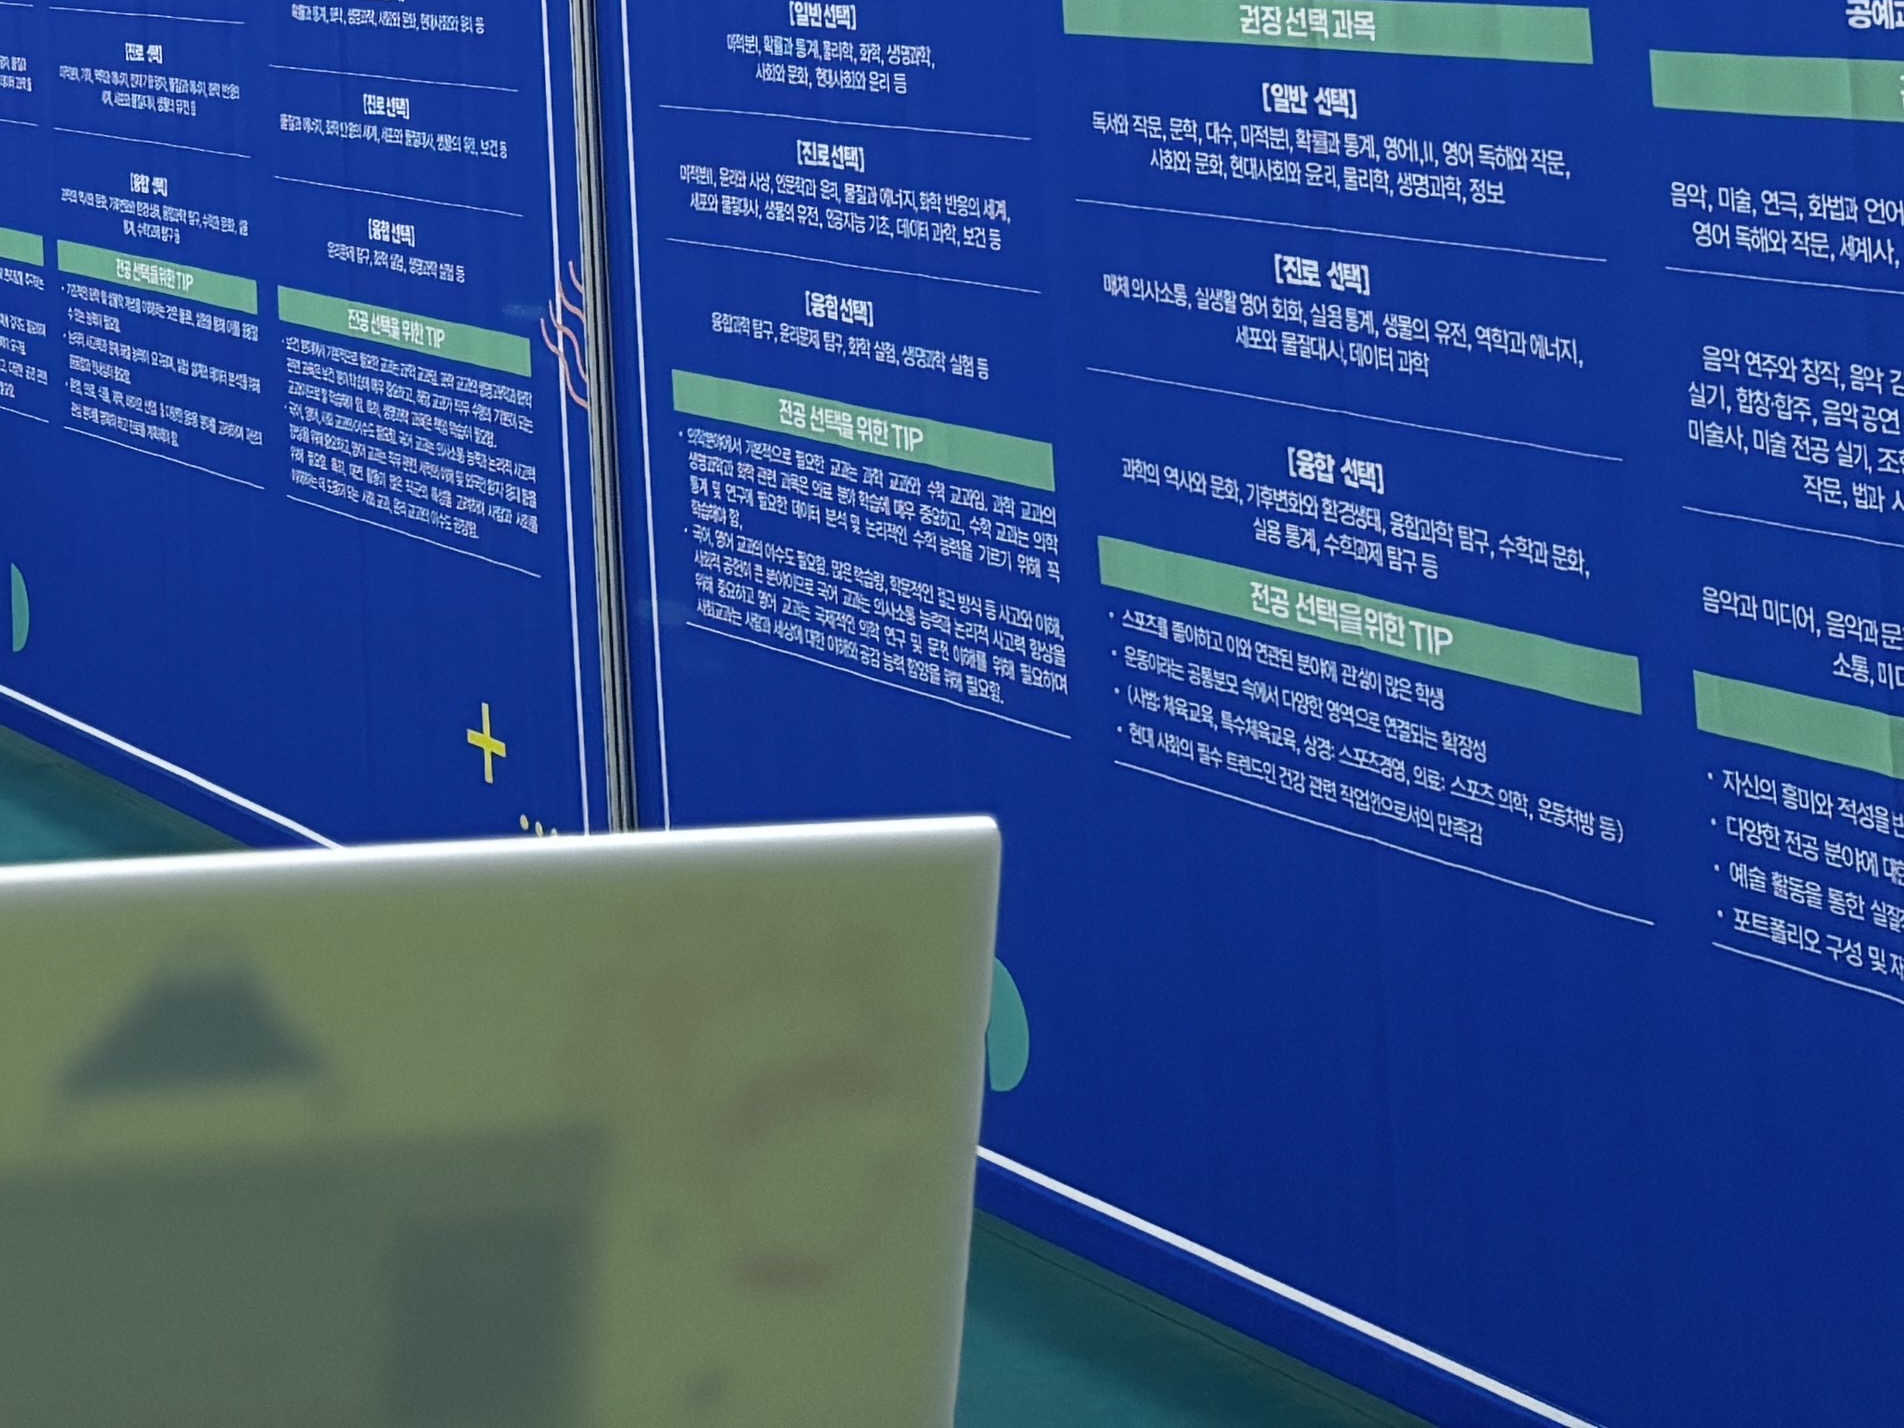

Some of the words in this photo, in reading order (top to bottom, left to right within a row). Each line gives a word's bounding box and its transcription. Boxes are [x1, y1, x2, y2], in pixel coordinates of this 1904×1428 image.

[1239, 4, 1281, 35] 권장
[1285, 8, 1329, 37] 선택
[1332, 10, 1375, 41] 과목
[1262, 82, 1308, 114] [일반
[1314, 87, 1357, 119] 선택]
[1132, 114, 1166, 142] 작문,
[1170, 117, 1202, 146] 문학,
[1344, 133, 1380, 162] 통계,
[1443, 141, 1474, 168] 영어
[1478, 144, 1528, 173] 독해와
[1530, 148, 1570, 179] 작문,
[1150, 148, 1191, 174] 사회와
[1195, 151, 1227, 180] 문화,
[1344, 166, 1394, 197] 물리학,
[1397, 172, 1467, 205] 생명과학,
[1470, 179, 1506, 204] 정보
[1670, 182, 1713, 213] 음악,
[1717, 187, 1757, 217] 미술,
[1761, 189, 1804, 221] 연극,
[1808, 193, 1857, 223] 화법과
[1692, 222, 1731, 249] 영어
[1735, 225, 1788, 255] 독해와
[1791, 230, 1835, 262] 작문,
[1274, 253, 1322, 288] [진로
[1327, 261, 1371, 296] 선택]
[425, 326, 445, 348] TIP
[779, 398, 805, 430] 전공
[809, 406, 854, 440] 선택을
[857, 417, 889, 448] 위한
[891, 424, 924, 452] TIP
[1722, 770, 1776, 805] 자신의
[1837, 797, 1889, 835] 적성을
